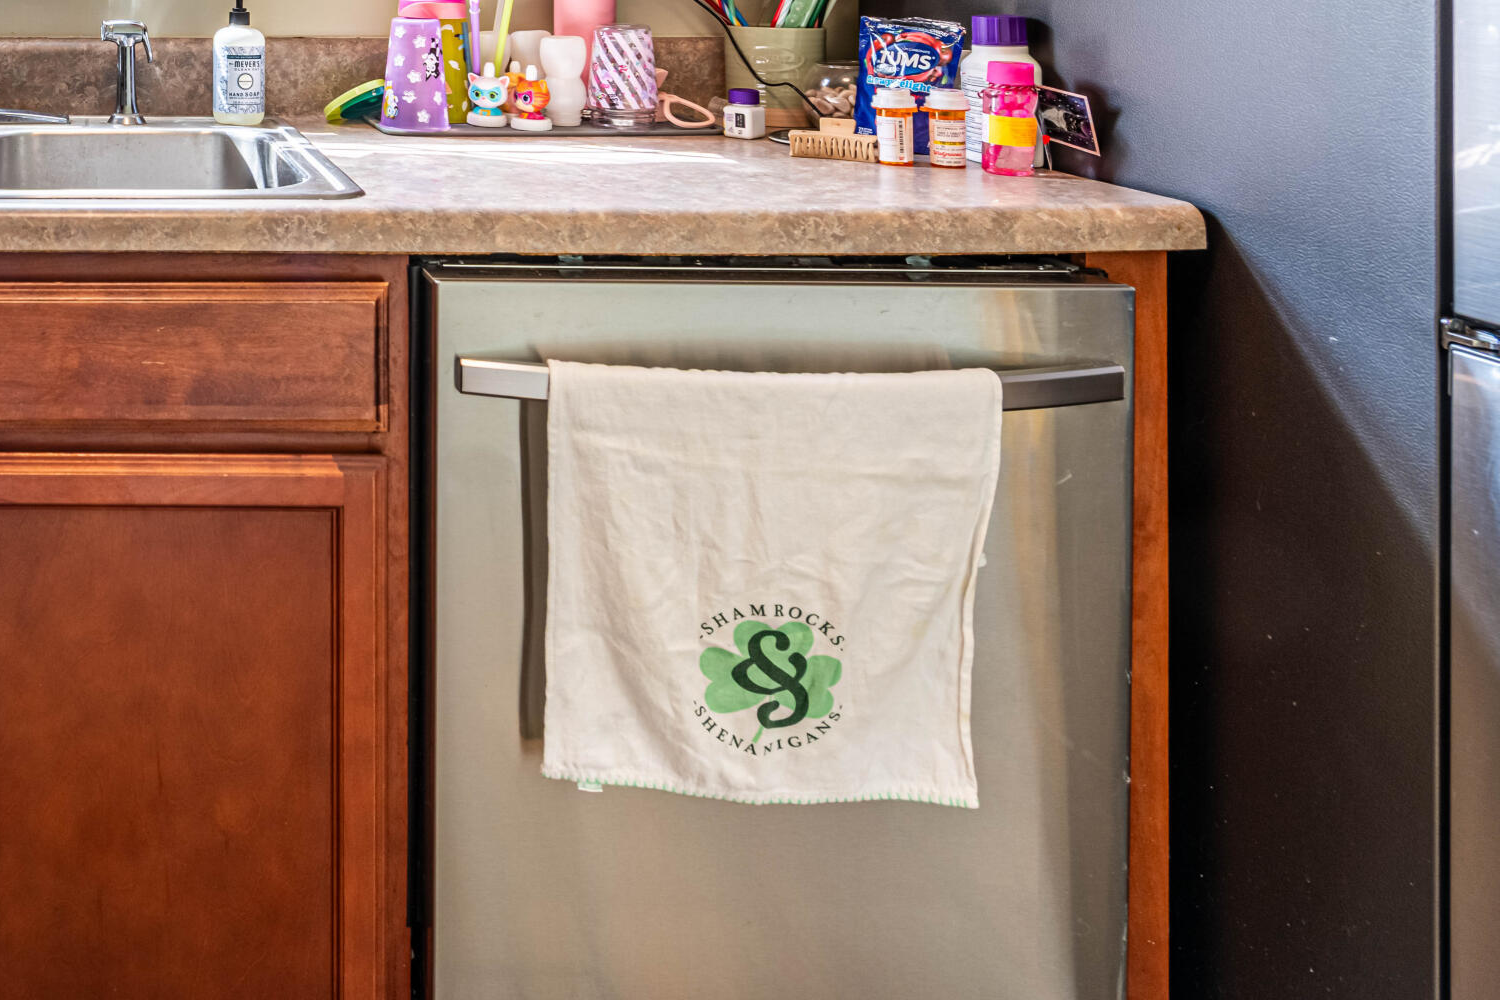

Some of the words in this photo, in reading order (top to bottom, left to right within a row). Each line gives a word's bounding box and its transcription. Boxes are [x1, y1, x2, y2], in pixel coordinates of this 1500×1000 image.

[879, 49, 932, 71] TUMS
[700, 604, 845, 647] SHAMROCKS
[693, 704, 842, 756] SHENANIGANS
